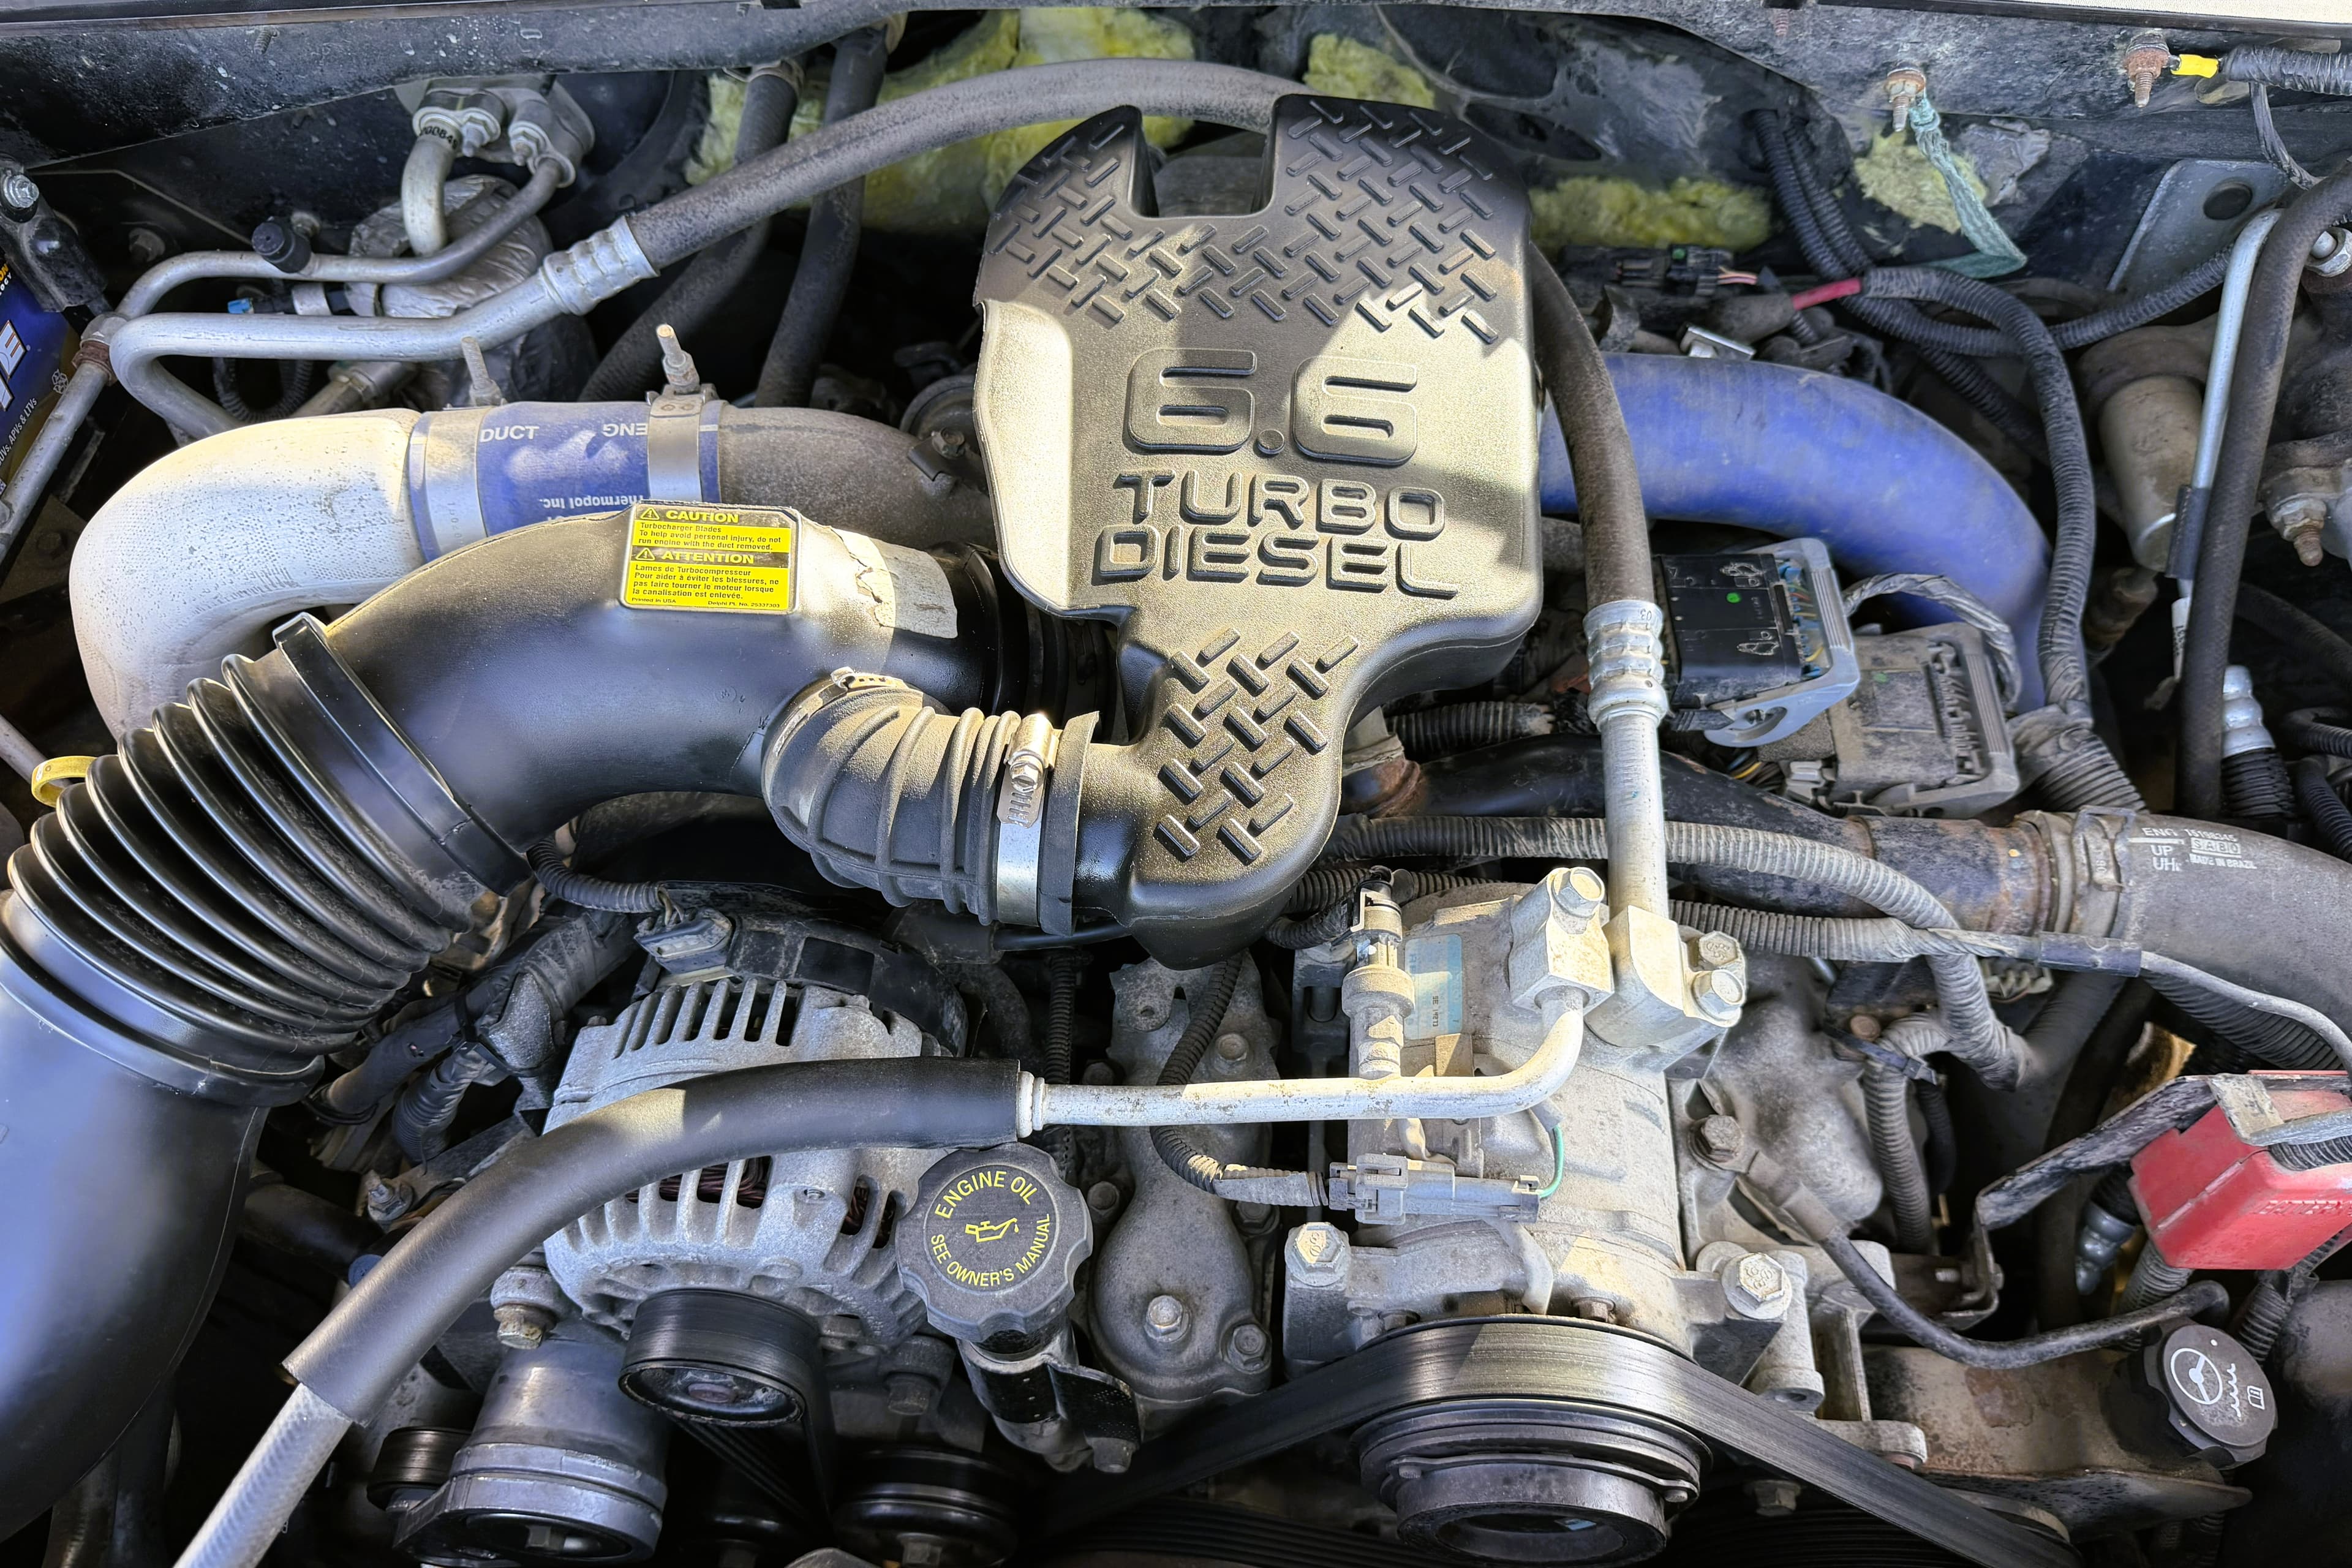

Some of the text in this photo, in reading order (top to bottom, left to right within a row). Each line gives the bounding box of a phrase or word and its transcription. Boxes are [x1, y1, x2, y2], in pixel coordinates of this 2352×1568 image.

[1128, 347, 1417, 467] 6.6
[8, 422, 23, 445] APVs
[20, 415, 26, 424] &
[24, 397, 37, 418] LTVs
[480, 426, 540, 443] DUCT
[602, 423, 648, 437] ENG
[539, 498, 565, 510] Inc.
[1116, 468, 1446, 540] TURBO
[665, 510, 739, 523] CAUTION
[641, 522, 693, 532] Turbocharger
[650, 530, 667, 539] help
[730, 535, 755, 543] injury,
[662, 552, 755, 564] ATTENTION
[1096, 524, 1458, 598] DIESEL
[677, 567, 751, 576] Turbocompresseur
[726, 576, 767, 586] blessures,
[643, 589, 692, 598] canalisation
[2150, 845, 2174, 856] UP
[934, 1170, 1038, 1219] ENGINE OIL
[930, 1213, 1050, 1287] SEE OWNER'S MANUAL
